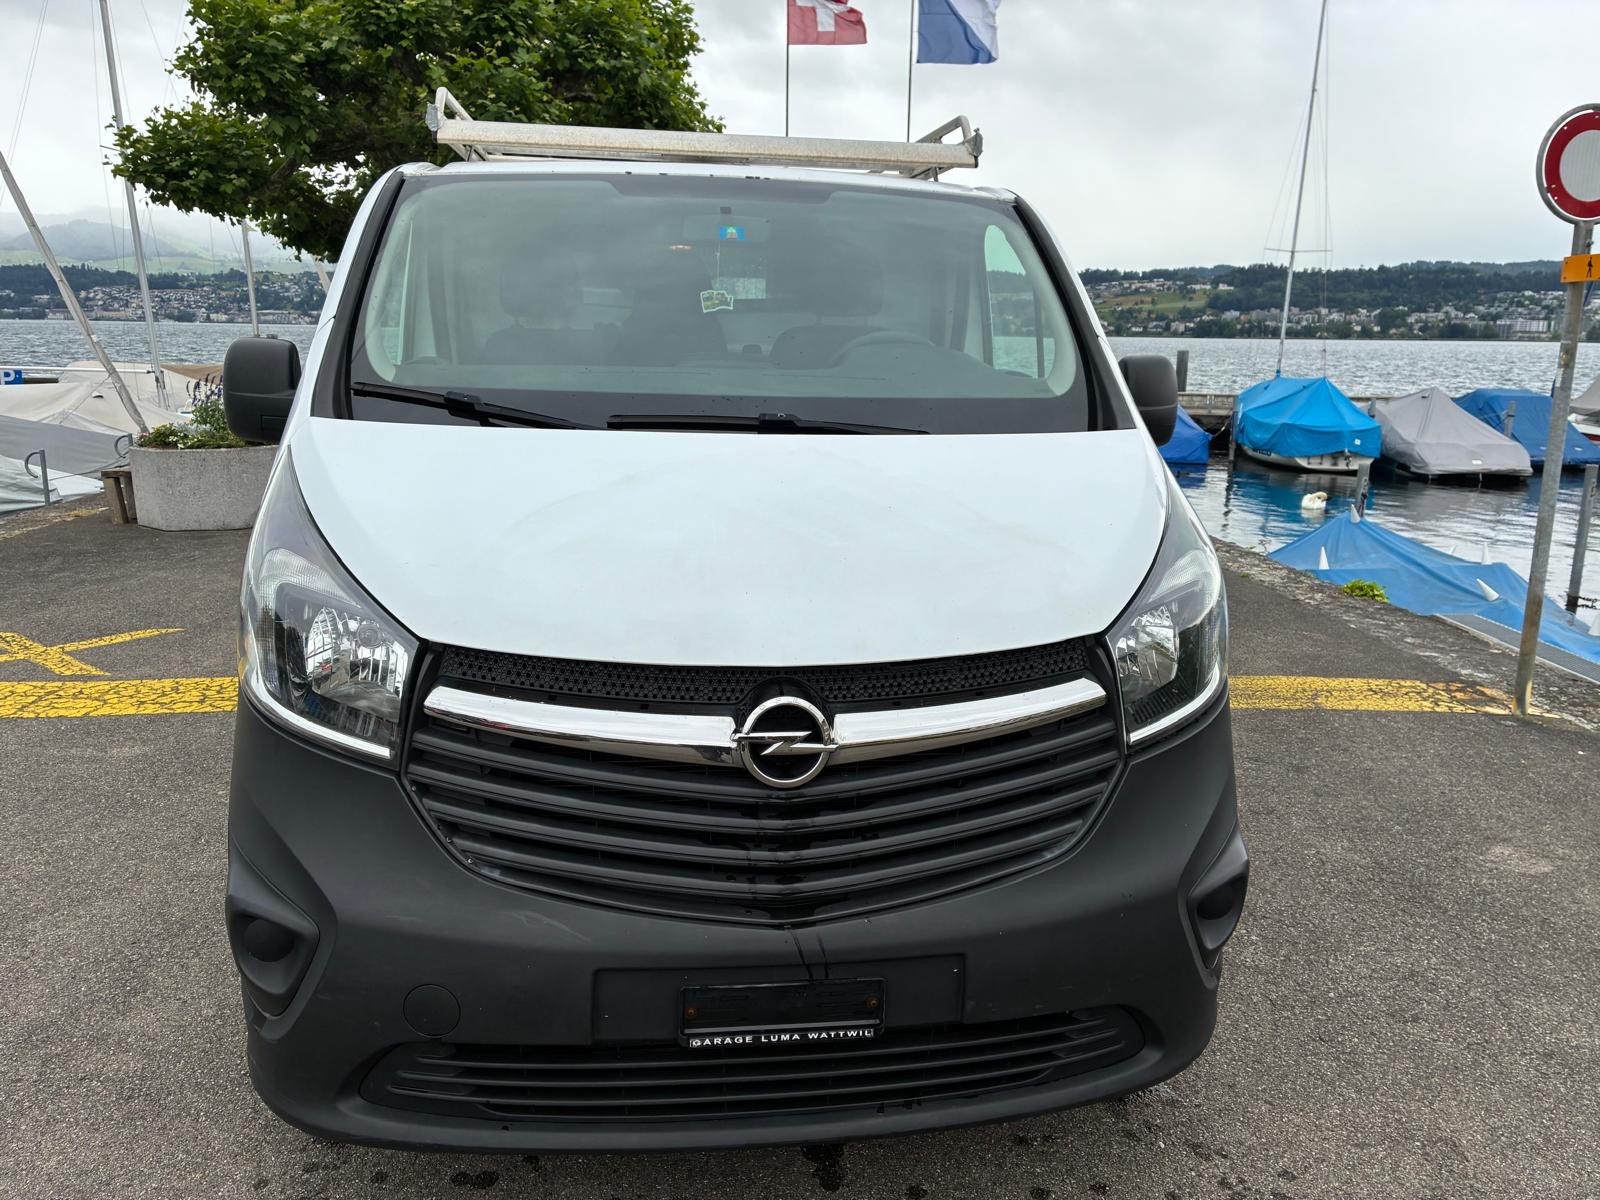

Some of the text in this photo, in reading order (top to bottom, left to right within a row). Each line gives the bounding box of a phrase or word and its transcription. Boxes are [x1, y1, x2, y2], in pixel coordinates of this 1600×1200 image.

[0, 370, 15, 385] P
[691, 1029, 872, 1046] GARAGE LUMA WATTWIL
